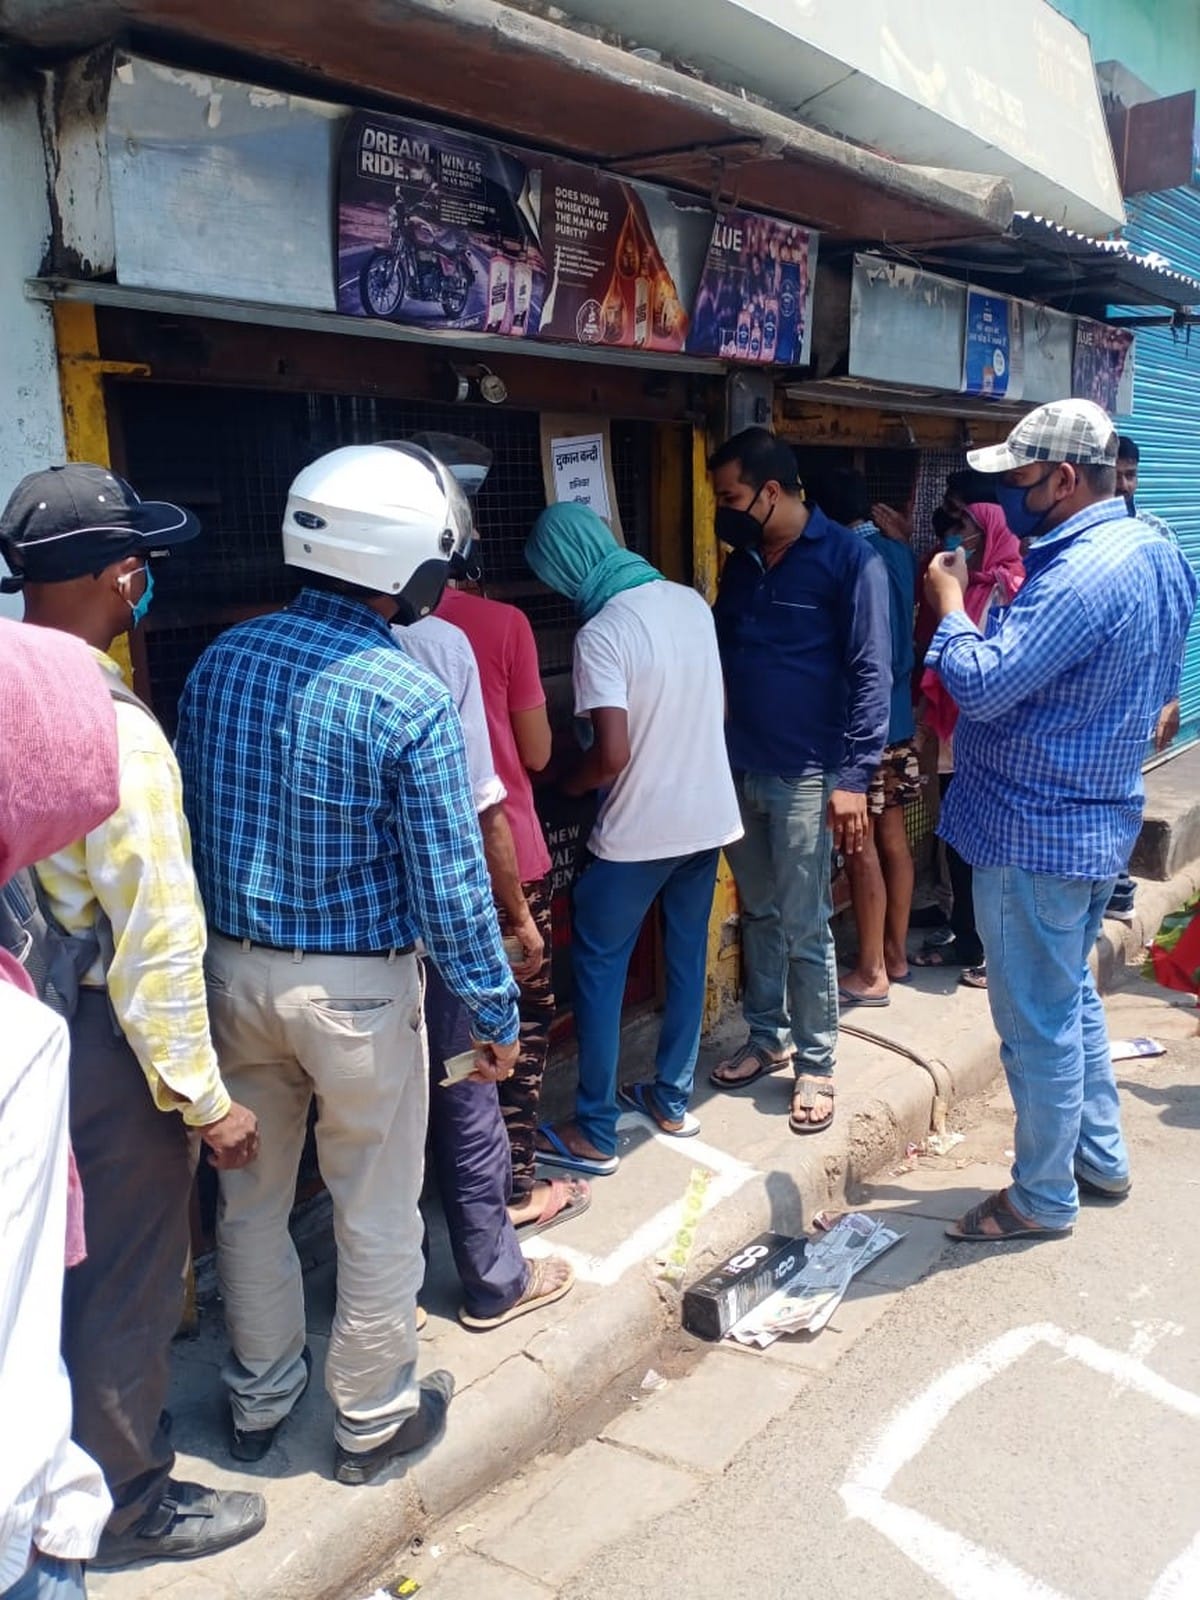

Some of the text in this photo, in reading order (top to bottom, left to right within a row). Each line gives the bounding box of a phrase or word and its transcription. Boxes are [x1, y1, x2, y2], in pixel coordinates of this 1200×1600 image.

[362, 128, 434, 164] DREAM.
[361, 150, 409, 180] RIDE.
[440, 153, 482, 175] WIN 45
[555, 186, 600, 207] DOES YOUR
[555, 199, 609, 221] WHISKY HAVE
[555, 211, 608, 232] THE MARK OF
[555, 223, 588, 240] PURITY?
[555, 452, 579, 471] दुकान
[548, 824, 579, 845] NEW
